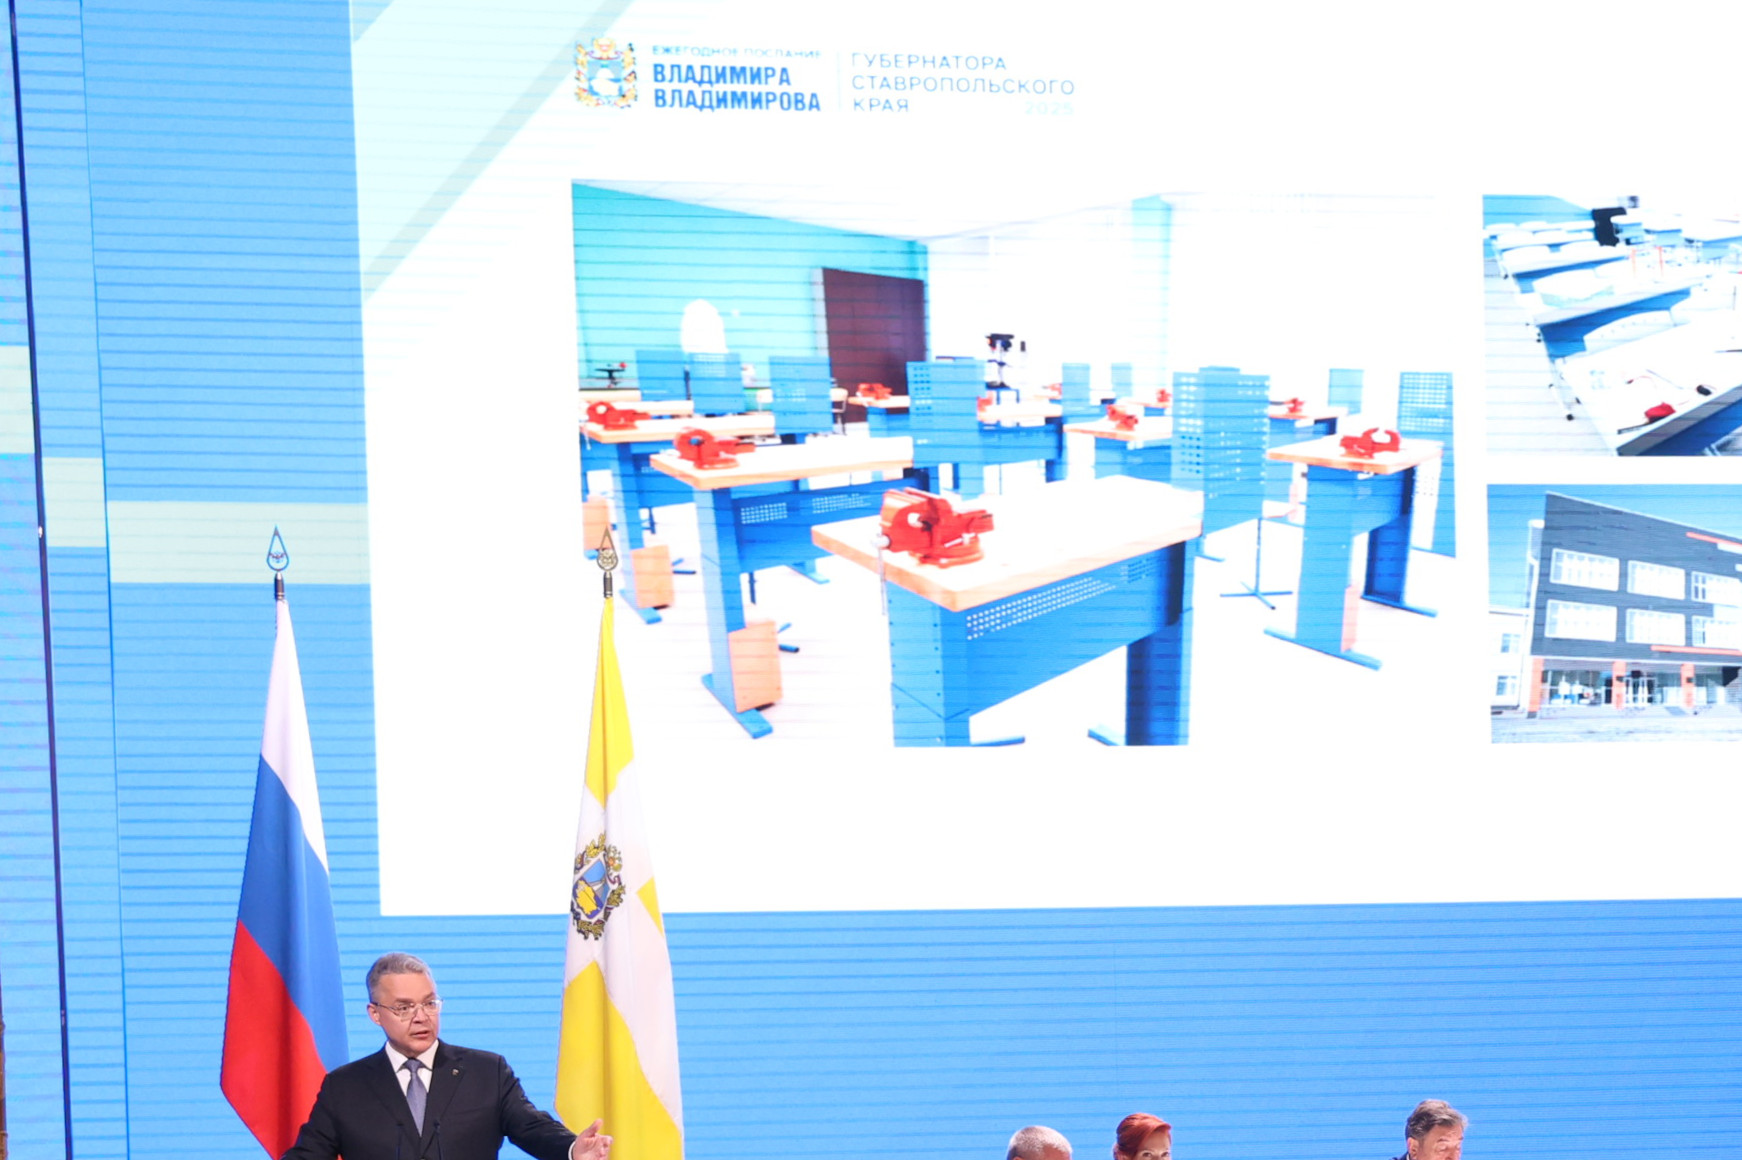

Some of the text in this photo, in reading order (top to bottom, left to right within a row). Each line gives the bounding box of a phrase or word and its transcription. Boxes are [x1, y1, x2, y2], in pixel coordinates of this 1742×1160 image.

[851, 52, 1007, 70] ГУБЕРНАТОРА
[653, 63, 792, 88] ВЛАДИМИРА
[851, 75, 1075, 95] СТАВРОПОЛЬСКОГО
[654, 88, 821, 113] ВЛАДИМИРОВА
[852, 98, 910, 113] КРАЯ
[1024, 100, 1075, 116] 2025
